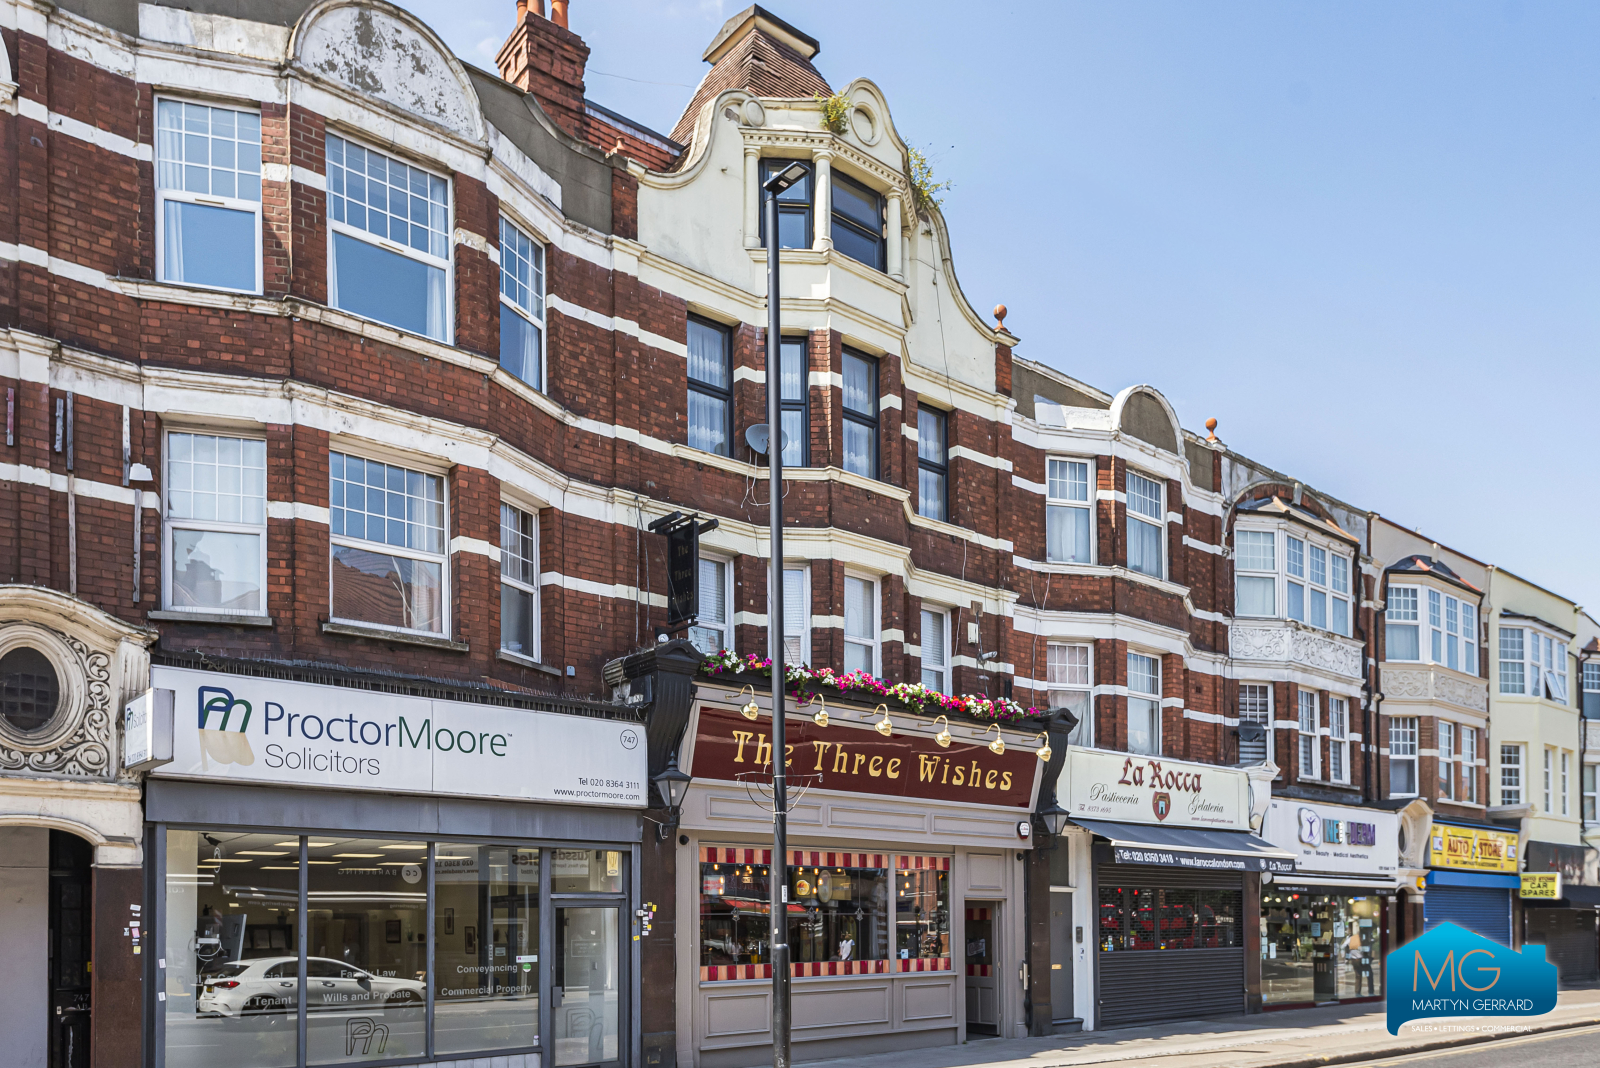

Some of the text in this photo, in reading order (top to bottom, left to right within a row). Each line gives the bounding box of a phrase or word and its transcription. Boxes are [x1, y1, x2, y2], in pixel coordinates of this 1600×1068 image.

[677, 545, 689, 557] The
[674, 569, 692, 582] Three
[622, 735, 635, 745] 747
[264, 743, 381, 776] Solicitors
[732, 730, 1013, 791] The Three Wishes
[1118, 757, 1203, 794] La Rocca
[578, 777, 640, 790] Tel 020 8364 3111
[553, 788, 640, 801] www.proctormoore.com
[1187, 792, 1224, 816] Gelateria
[1447, 837, 1503, 857] AUTO STORE
[1132, 851, 1143, 861] 020
[1521, 889, 1556, 897] SPARES
[376, 968, 397, 978] Law
[456, 963, 518, 975] Conveyancing
[323, 990, 411, 1003] Wills and Probate
[441, 984, 532, 997] Commercial Property
[254, 996, 293, 1006] Tenant
